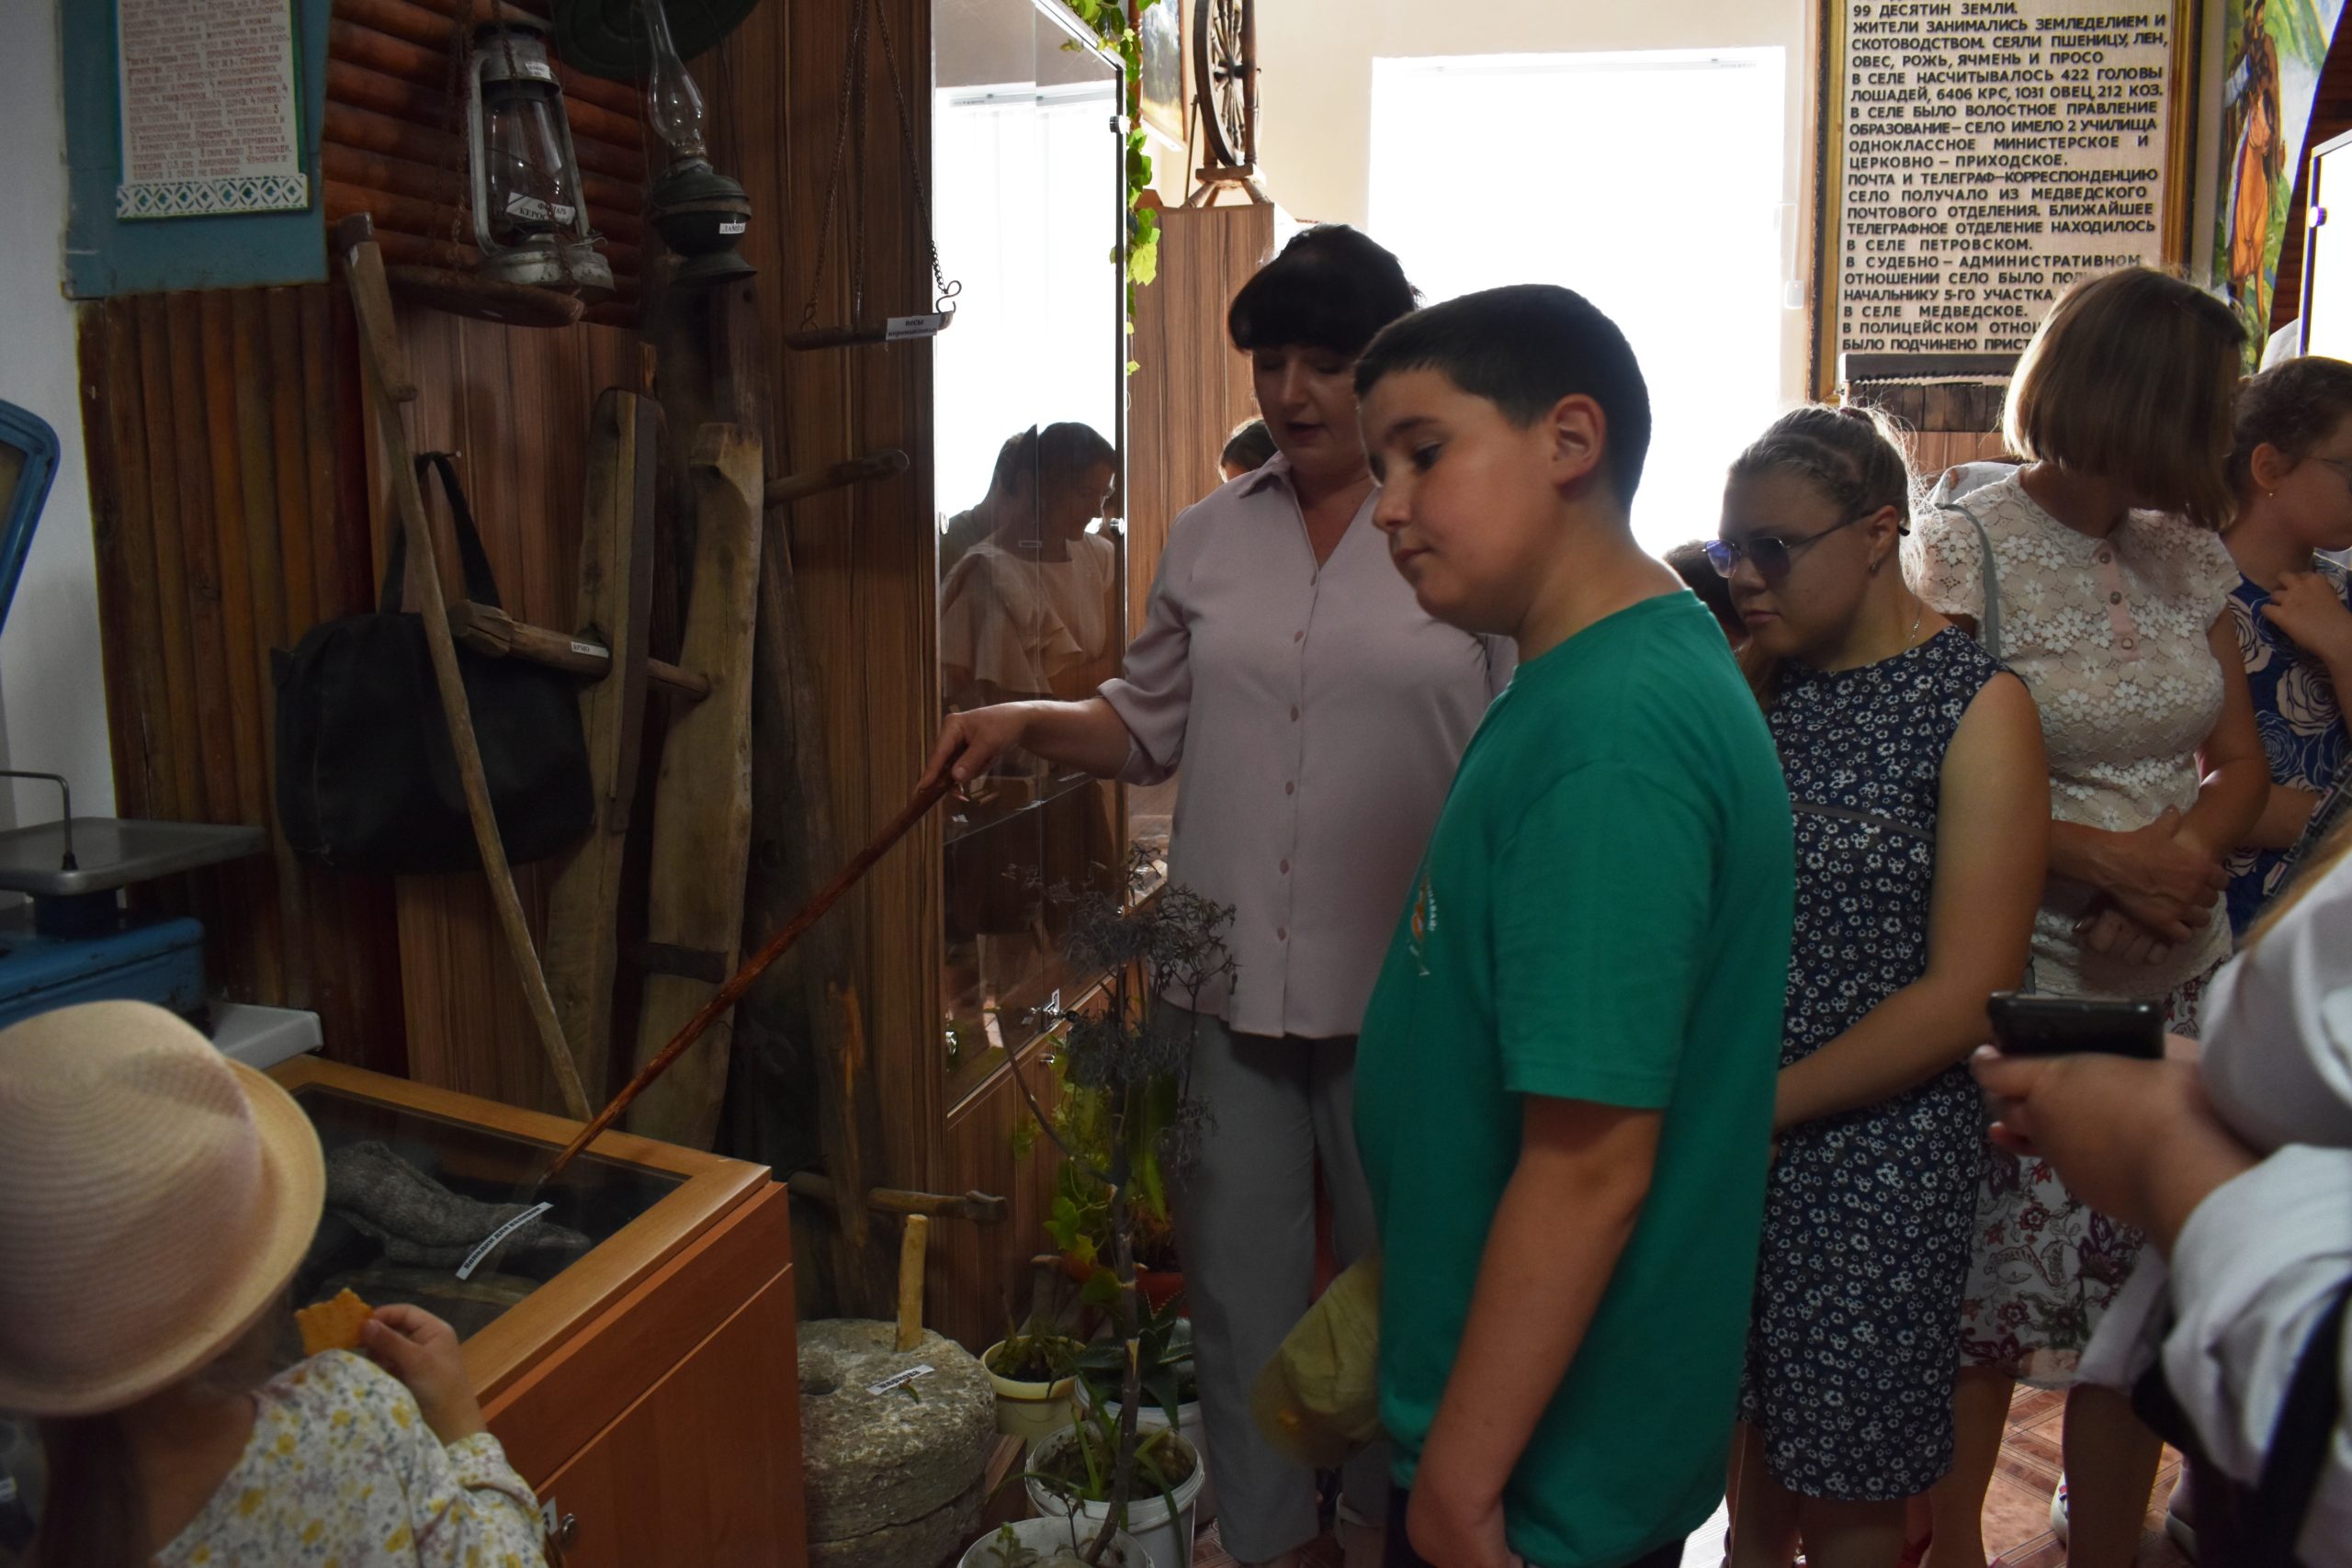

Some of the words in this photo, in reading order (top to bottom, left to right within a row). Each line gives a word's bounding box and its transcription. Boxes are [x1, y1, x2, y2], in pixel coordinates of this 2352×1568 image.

[1853, 6, 1871, 17] 99
[1880, 5, 1951, 18] ДЕСЯТИН
[1961, 3, 2018, 15] ЗЕМЛИ.
[1854, 22, 1918, 33] ЖИТЕЛИ
[1927, 20, 2027, 33] ЗАНИМАЛИСЬ
[2036, 16, 2147, 31] ЗЕМЛЕДЕЛИЕМ
[2154, 15, 2165, 26] И
[1993, 36, 2041, 48] СЕЯЛИ
[2052, 33, 2128, 48] ПШЕНИЦУ,
[2133, 33, 2168, 47] ЛЕН,
[1852, 56, 1894, 70] ОВЕС,
[1904, 55, 1953, 68] РОЖЬ,
[1957, 53, 2021, 66] ЯЧМЕНЬ
[2030, 53, 2040, 64] И
[2051, 51, 2103, 64] ПРОСО
[1852, 73, 1860, 85] В
[1869, 73, 1905, 85] СЕЛЕ
[1917, 69, 2053, 84] НАСЧИТЫВАЛОСЬ
[2062, 69, 2089, 81] 422
[2098, 67, 2162, 80] ГОЛОВЫ
[1851, 86, 1931, 103] ЛОШАДЕЙ,
[1937, 88, 1973, 100] 6406
[1978, 88, 2011, 102] КРС,
[2098, 85, 2122, 97] 212
[2130, 85, 2163, 96] КОЗ.
[1851, 107, 1860, 118] В
[1869, 107, 1904, 118] СЕЛЕ
[1914, 106, 1957, 118] БЫЛО
[1966, 104, 2056, 116] ВОЛОСТНОЕ
[2067, 102, 2157, 114] ПРАВЛЕНИЕ
[1965, 121, 2005, 132] СЕЛО
[2012, 120, 2064, 132] ИМЕЛО
[2068, 120, 2076, 131] 2
[2081, 118, 2156, 132] УЧИЛИЩА
[1849, 140, 1975, 153] ОДНОКЛАССНОЕ
[1994, 136, 2119, 149] МИНИСТЕРСКОЕ
[2138, 136, 2148, 147] И
[1850, 156, 1933, 171] ЦЕРКОВНО
[1956, 154, 2067, 167] ПРИХОДСКОЕ.
[1849, 175, 1894, 186] ПОЧТА
[1904, 174, 1913, 184] И
[1849, 191, 1889, 202] СЕЛО
[1902, 189, 1988, 201] ПОЛУЧАЛО
[2000, 189, 2019, 200] ИЗ
[2031, 186, 2147, 201] МЕДВЕДСКОГО
[1849, 207, 1937, 219] ПОЧТОВОГО
[1948, 206, 2040, 219] ОТДЕЛЕНИЯ.
[2050, 201, 2154, 216] БЛИЖАЙШЕЕ
[1849, 222, 1948, 235] ТЕЛЕГРАФНОЕ
[1956, 222, 2043, 236] ОТДЕЛЕНИЕ
[2052, 220, 2155, 235] НАХОДИЛОСЬ
[1847, 241, 1855, 250] В
[1866, 240, 1905, 251] СЕЛЕ
[1920, 239, 2032, 250] ПЕТРОВСКОМ.
[1847, 257, 1854, 267] В
[1867, 257, 1939, 269] СУДЕБНО
[1960, 254, 2141, 268] АДМИНИСТРАТИВНОМ
[1845, 274, 1939, 285] ОТНОШЕНИИ
[1950, 274, 1988, 284] СЕЛО
[1999, 272, 2043, 284] БЫЛО
[1845, 290, 1939, 301] НАЧАЛЬНИКУ
[1944, 289, 1975, 300] 5-ГО
[1845, 307, 1852, 317] В
[1862, 307, 1902, 317] СЕЛЕ
[1920, 305, 2027, 319] МЕДВЕДСКОЕ.
[1843, 323, 1850, 333] В
[1860, 320, 1977, 335] ПОЛИЦЕЙСКОМ
[1843, 340, 1883, 350] БЫЛО
[1891, 339, 1977, 353] ПОДЧИНЕНО
[1984, 338, 2031, 350] ПРИСТ
